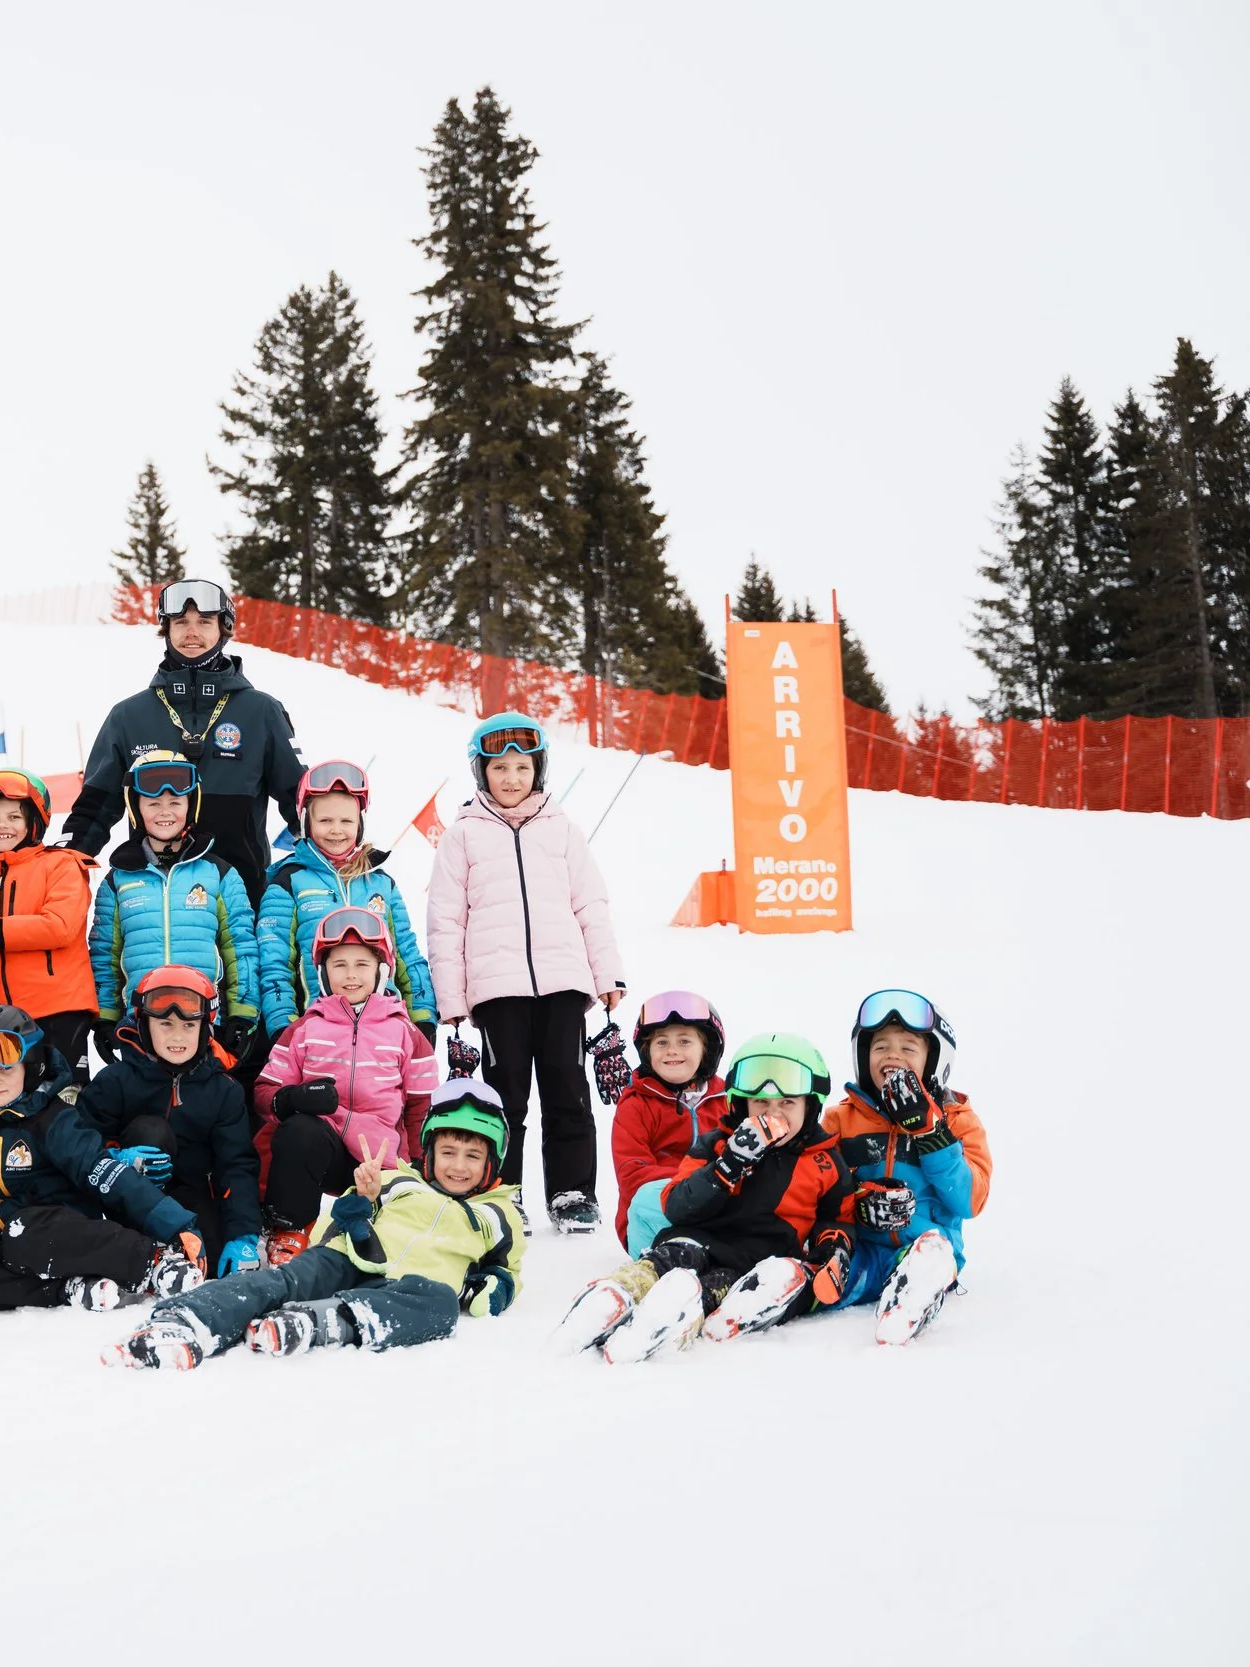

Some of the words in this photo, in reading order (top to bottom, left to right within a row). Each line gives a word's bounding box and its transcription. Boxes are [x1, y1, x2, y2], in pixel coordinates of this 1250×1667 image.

[135, 743, 158, 751] ALTURA
[770, 641, 809, 844] ARRIVO
[753, 856, 837, 876] Merano
[755, 877, 839, 903] 2000
[908, 1075, 919, 1092] LEKI
[902, 1115, 921, 1126] LEKI
[813, 1152, 832, 1174] 52
